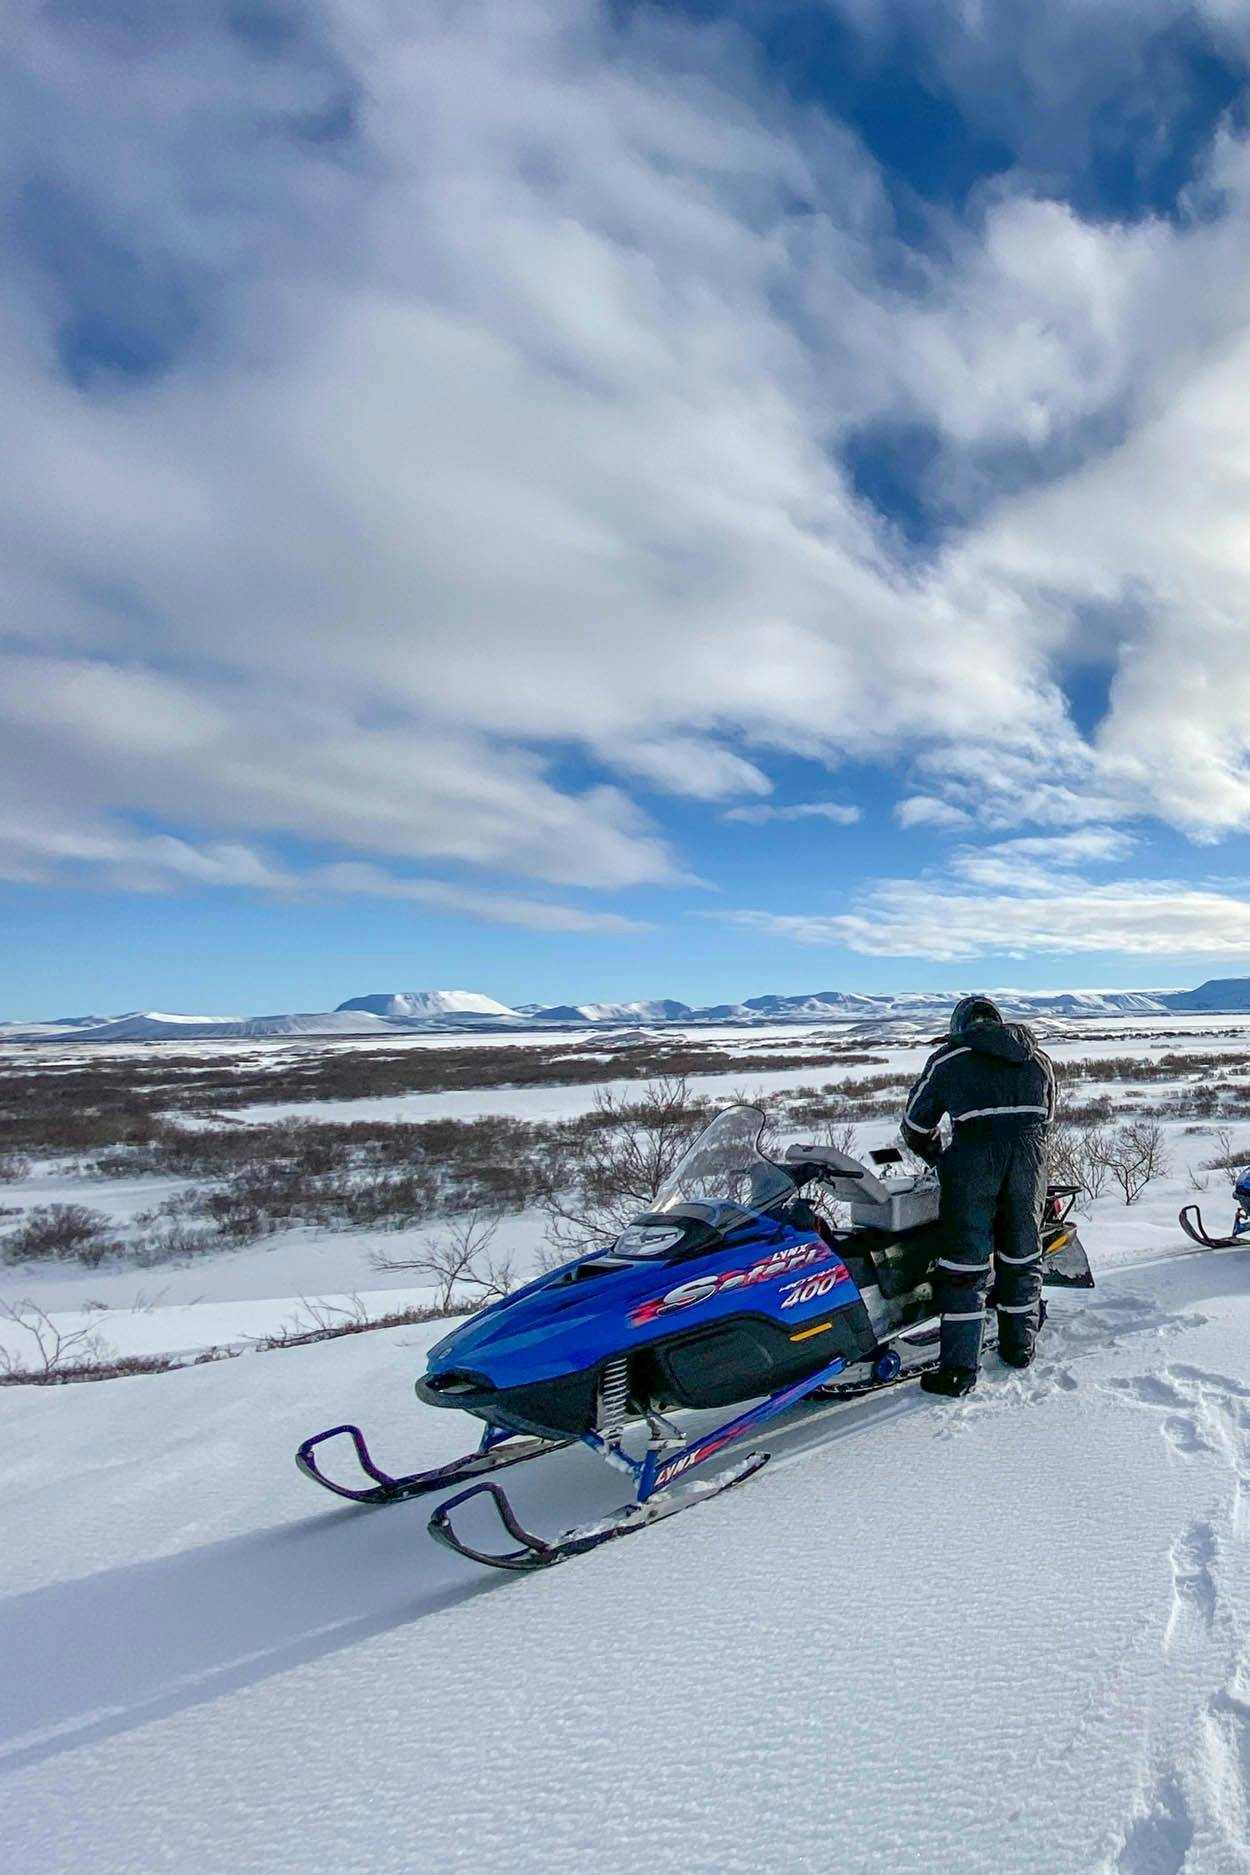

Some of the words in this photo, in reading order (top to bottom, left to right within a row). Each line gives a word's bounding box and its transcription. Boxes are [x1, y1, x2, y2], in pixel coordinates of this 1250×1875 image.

[771, 1243, 809, 1261] LYNX
[656, 1249, 816, 1317] Safari
[780, 1274, 836, 1309] 400
[655, 1449, 702, 1486] LYNX
